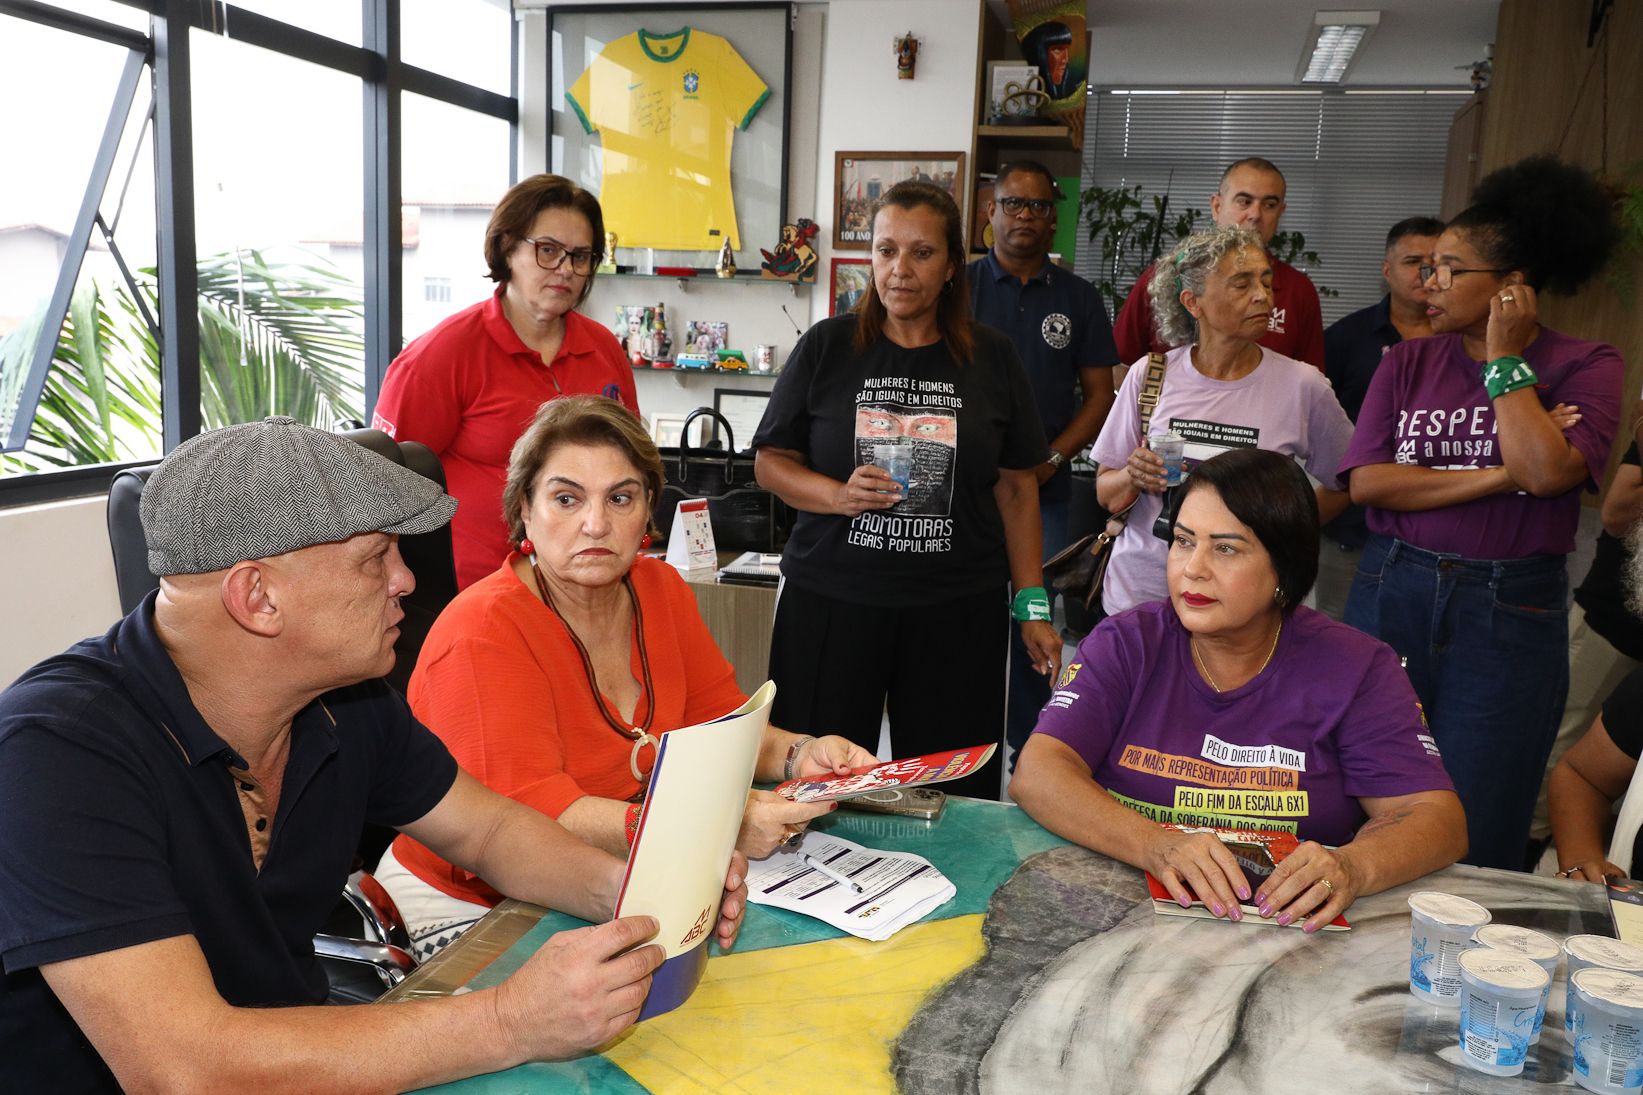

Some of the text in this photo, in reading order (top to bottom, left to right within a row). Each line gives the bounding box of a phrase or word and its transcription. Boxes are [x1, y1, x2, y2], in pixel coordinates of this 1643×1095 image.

[841, 231, 854, 241] 100
[864, 377, 954, 394] MULHERES E HOMENS
[856, 390, 963, 408] SÃO IGUAIS EM DIREITOS
[1173, 421, 1213, 431] MULHERES
[1221, 427, 1254, 436] HOMENS
[1183, 429, 1209, 438] IGUAIS
[1222, 435, 1257, 445] DIREITOS
[1424, 440, 1493, 457] a nossa
[847, 530, 951, 553] LEGAIS POPULARES
[1206, 740, 1301, 768] PELO DIREITO À VIDA
[1124, 749, 1293, 787] POR MAIS REPRESENTAÇÃO POLÍTICA
[1179, 791, 1304, 811] PELO FIM DA ESCALA 6X1
[1160, 810, 1173, 824] DA
